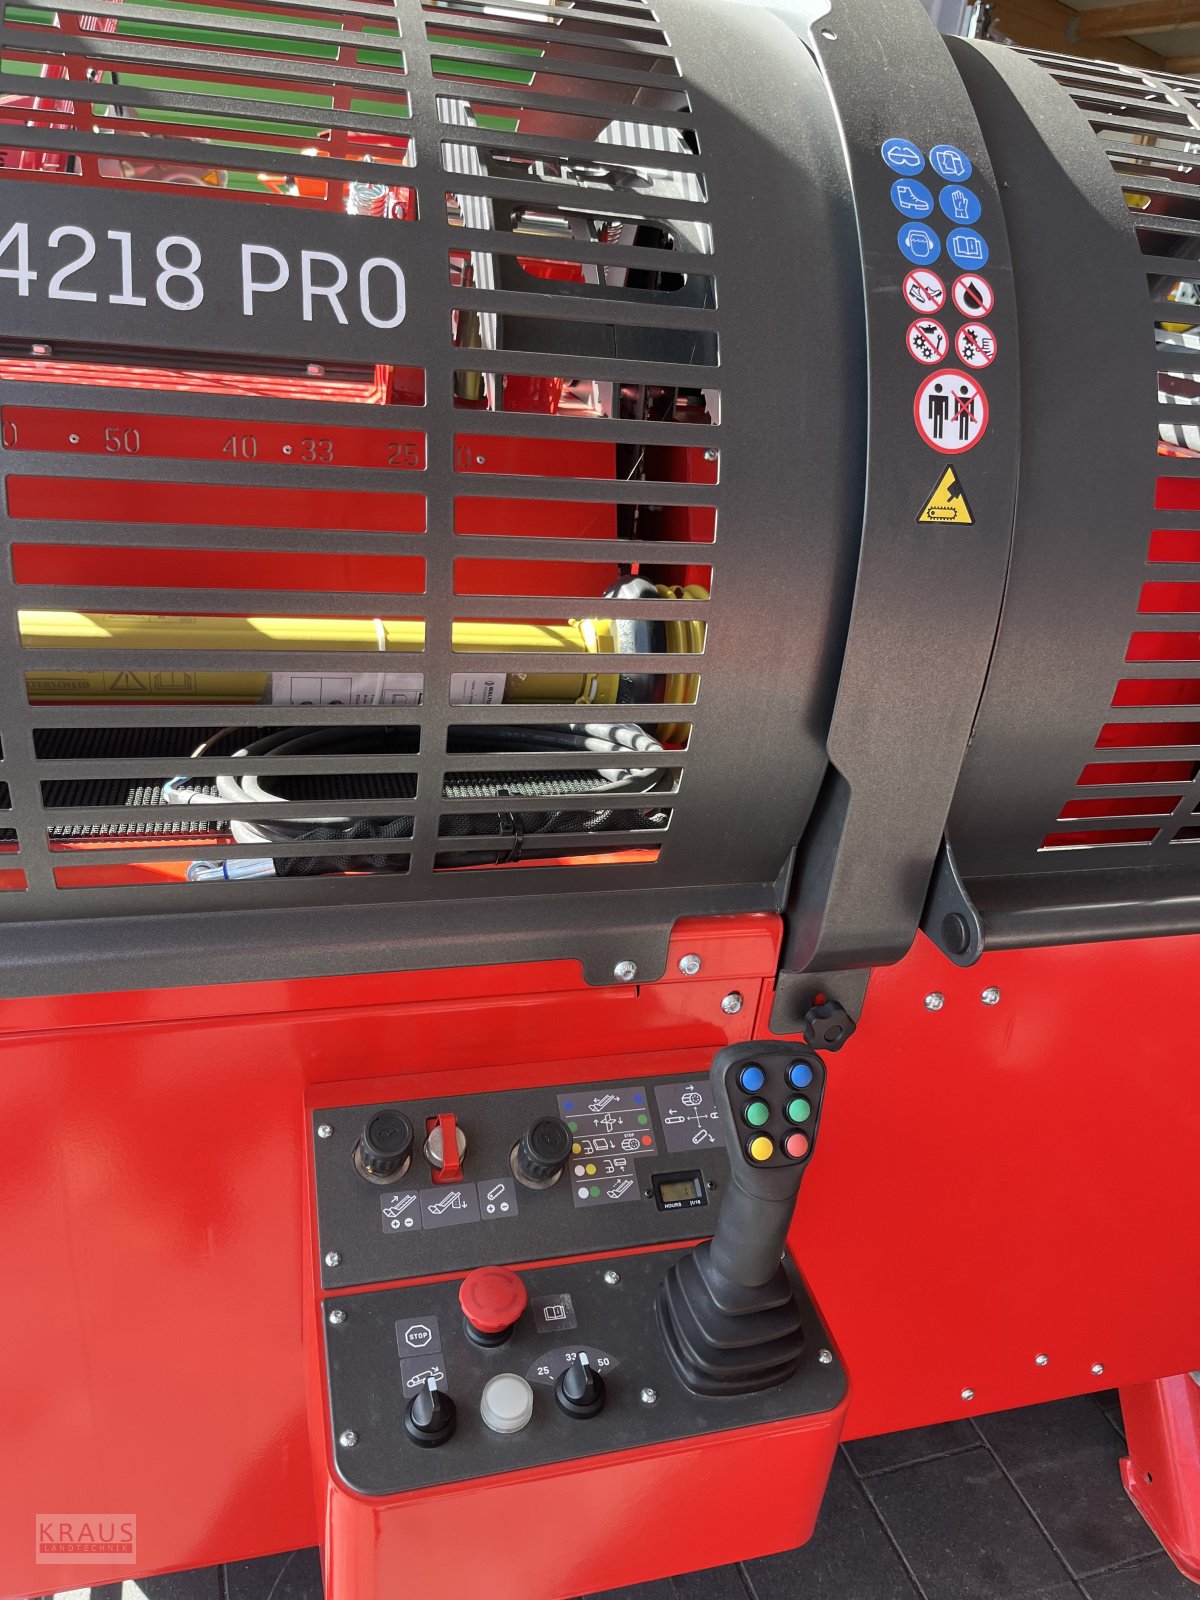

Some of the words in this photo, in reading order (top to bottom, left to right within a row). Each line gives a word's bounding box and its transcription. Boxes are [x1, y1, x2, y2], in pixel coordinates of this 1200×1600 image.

[0, 222, 204, 311] 4218
[241, 243, 407, 329] PRO
[104, 427, 141, 453] 50
[222, 434, 258, 459] 40
[301, 438, 334, 463] 33
[387, 443, 420, 466] 25
[409, 1332, 427, 1340] STOP
[537, 1366, 550, 1375] 25
[565, 1352, 577, 1361] 33
[597, 1358, 609, 1366] 50
